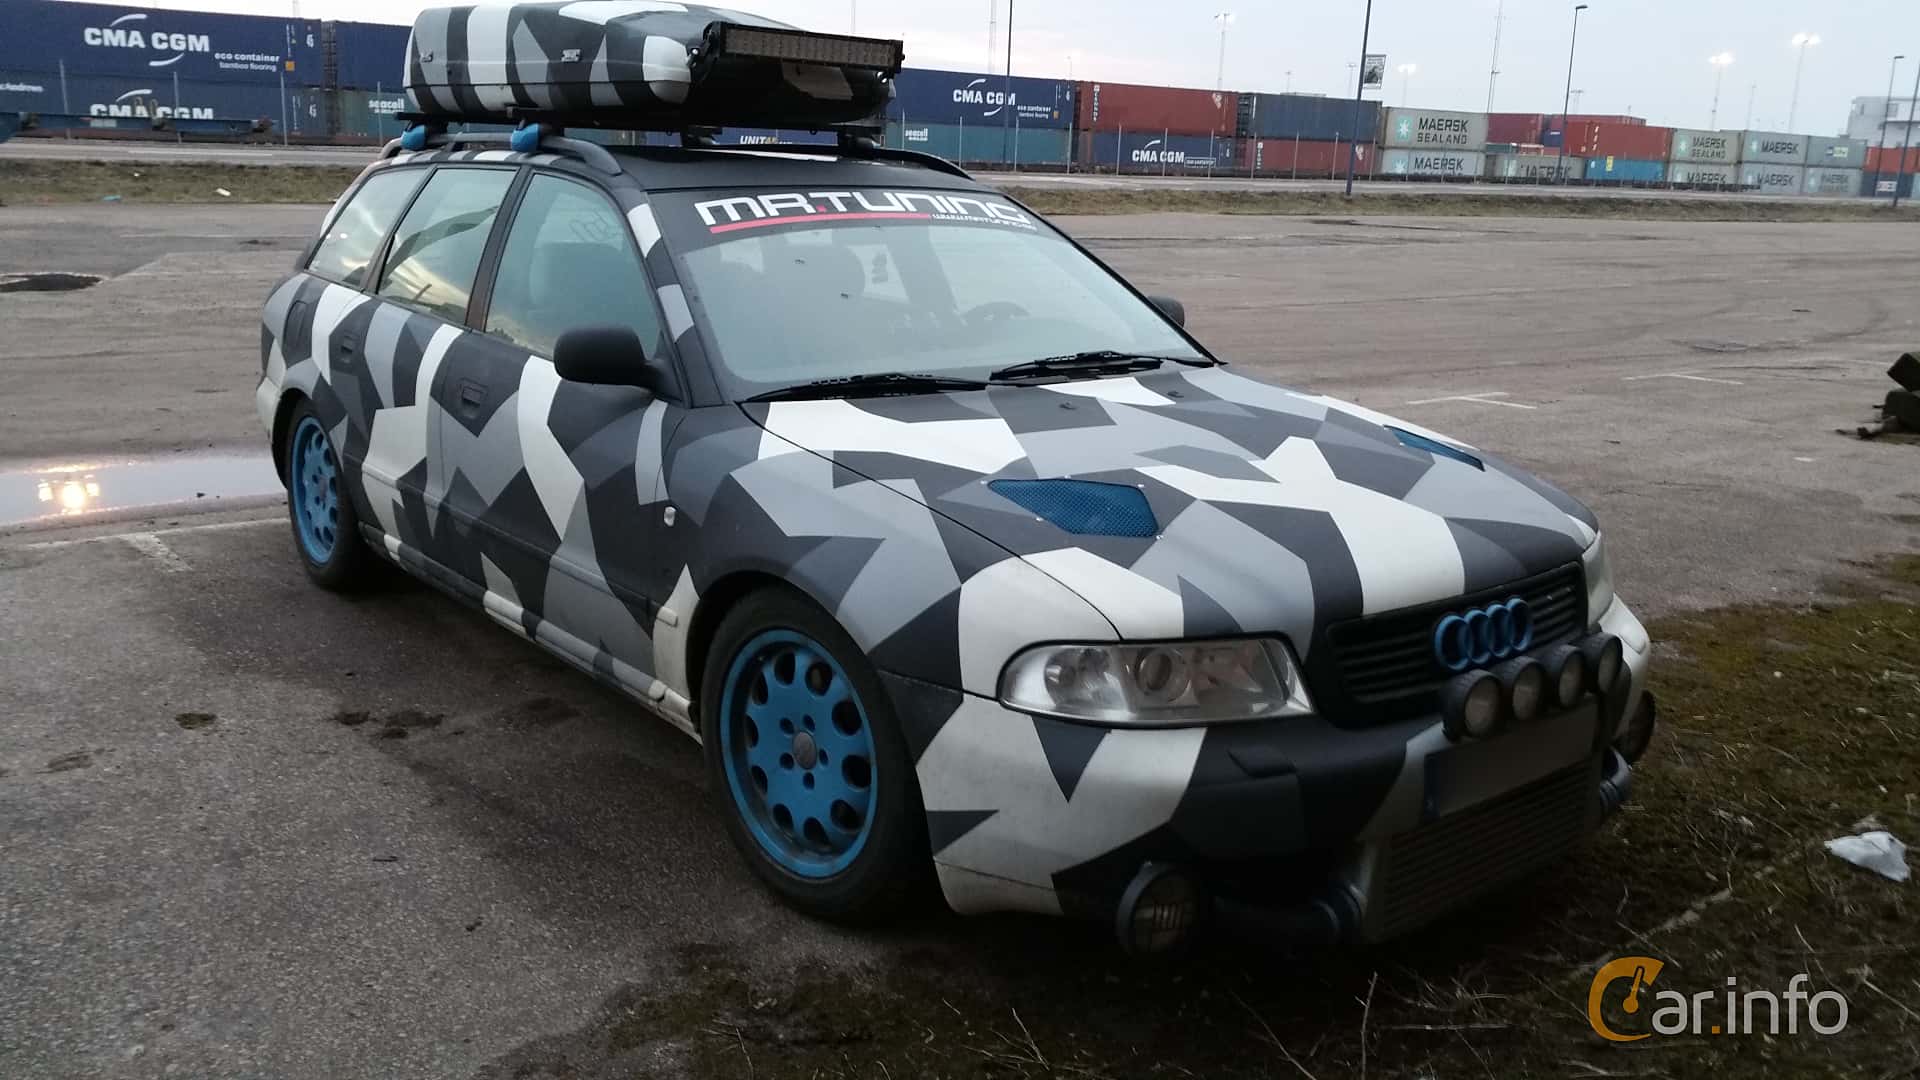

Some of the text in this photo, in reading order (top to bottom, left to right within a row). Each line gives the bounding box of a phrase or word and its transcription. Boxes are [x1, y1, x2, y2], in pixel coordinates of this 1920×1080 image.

[84, 27, 210, 52] CMA CGM
[214, 52, 280, 63] eco container
[953, 89, 1016, 106] CMA CGM
[90, 103, 214, 120] CMA CGM
[1418, 117, 1469, 133] MAERSK
[1417, 132, 1468, 145] SEALAND
[1692, 136, 1728, 149] MAERSK
[1760, 140, 1800, 154] MAERSK
[1132, 150, 1157, 163] CMA
[1159, 151, 1185, 163] CGM
[1414, 157, 1464, 171] MAERSK
[1757, 173, 1795, 186] MAERSK
